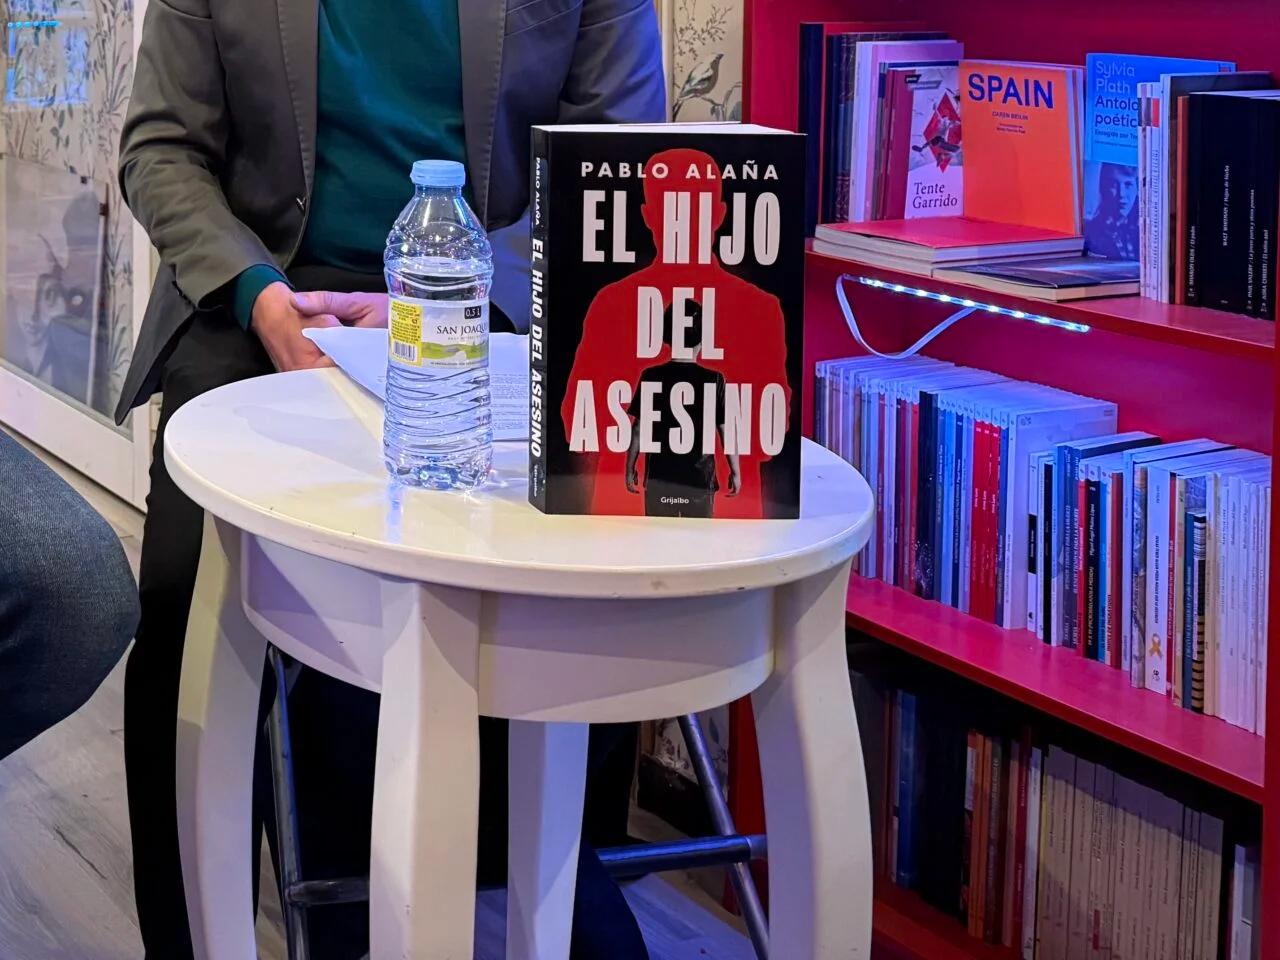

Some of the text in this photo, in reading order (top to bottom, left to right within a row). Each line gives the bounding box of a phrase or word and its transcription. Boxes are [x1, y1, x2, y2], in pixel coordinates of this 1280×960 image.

[1095, 60, 1135, 78] Sylvia
[968, 73, 1054, 109] SPAIN
[1096, 78, 1131, 94] Plath
[1095, 95, 1138, 111] Antolo
[1095, 112, 1138, 128] poétic
[581, 159, 779, 180] PABLO ALAÑA
[914, 182, 945, 195] Tente
[912, 195, 958, 209] Garrido
[582, 189, 781, 266] EL HIJO
[437, 326, 457, 334] SAN
[636, 286, 724, 360] DEL
[531, 239, 544, 458] EL HIJO DEL ASESINO
[568, 379, 787, 456] ASESINO
[660, 496, 690, 505] Grijalbo
